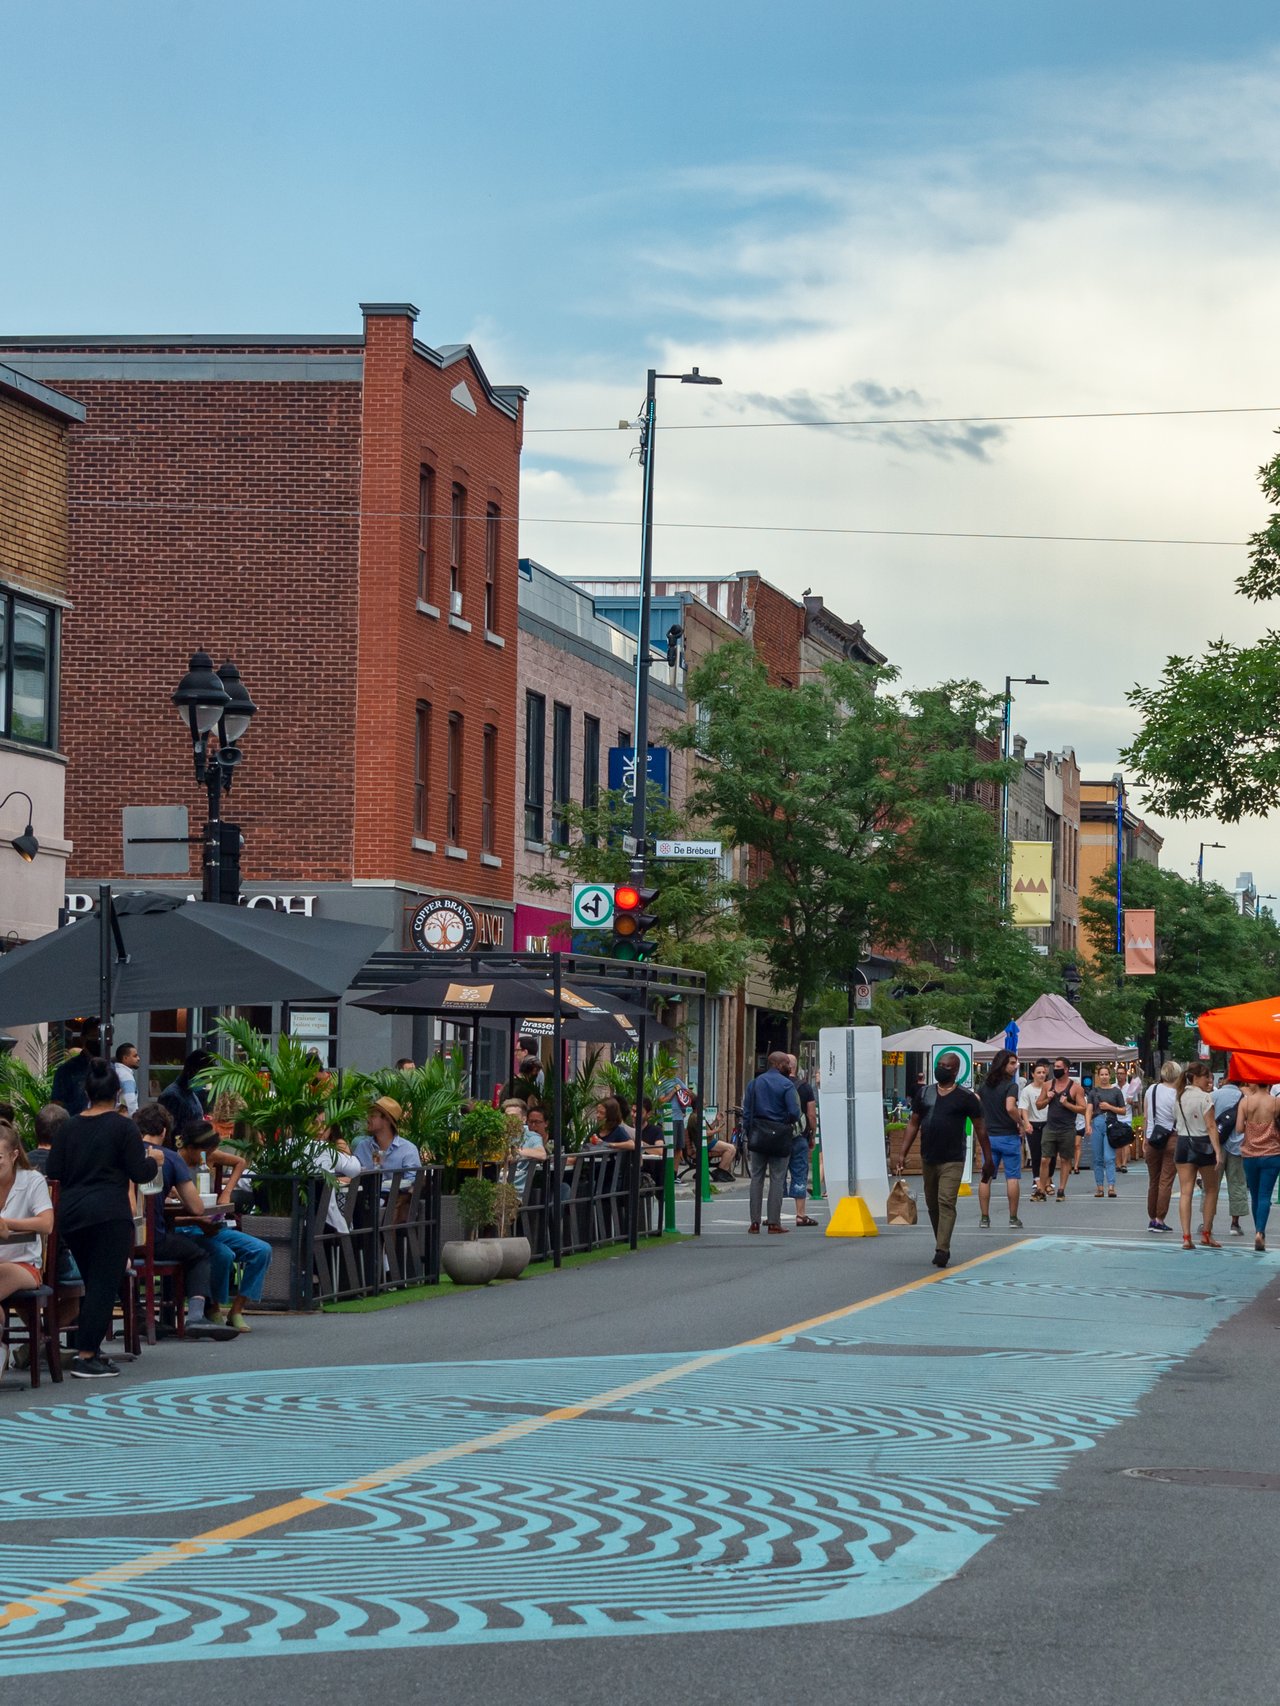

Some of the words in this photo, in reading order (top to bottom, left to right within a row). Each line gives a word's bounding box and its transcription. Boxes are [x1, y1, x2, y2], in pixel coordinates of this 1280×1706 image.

[674, 846, 686, 854] De
[686, 846, 717, 855] Brébeuf
[414, 900, 443, 931] COPPER
[444, 900, 474, 931] BRANCH
